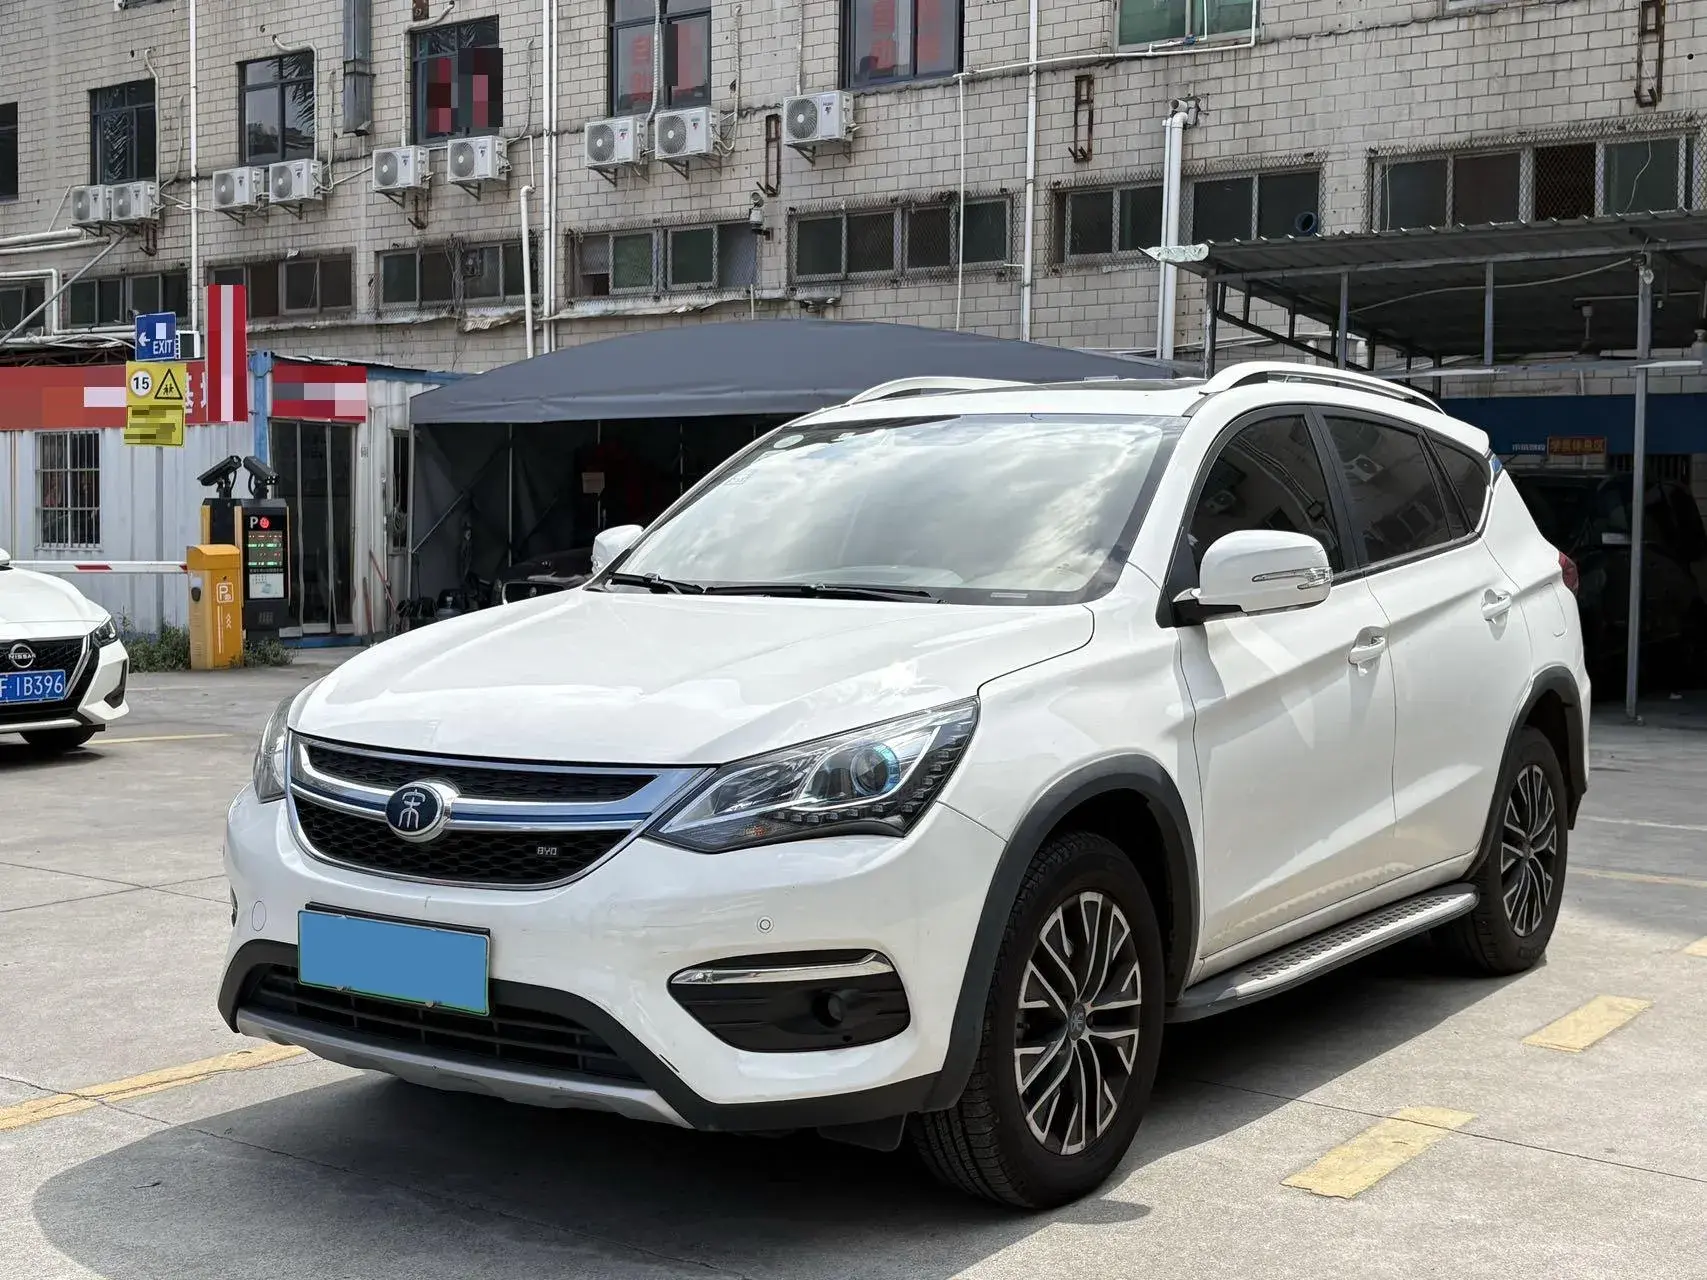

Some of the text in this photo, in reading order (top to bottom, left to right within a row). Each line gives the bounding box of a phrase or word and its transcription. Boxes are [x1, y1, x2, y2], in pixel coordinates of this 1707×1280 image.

[152, 339, 173, 355] EXIT
[133, 376, 150, 391] 15
[249, 516, 259, 529] P
[536, 846, 557, 856] BYD
